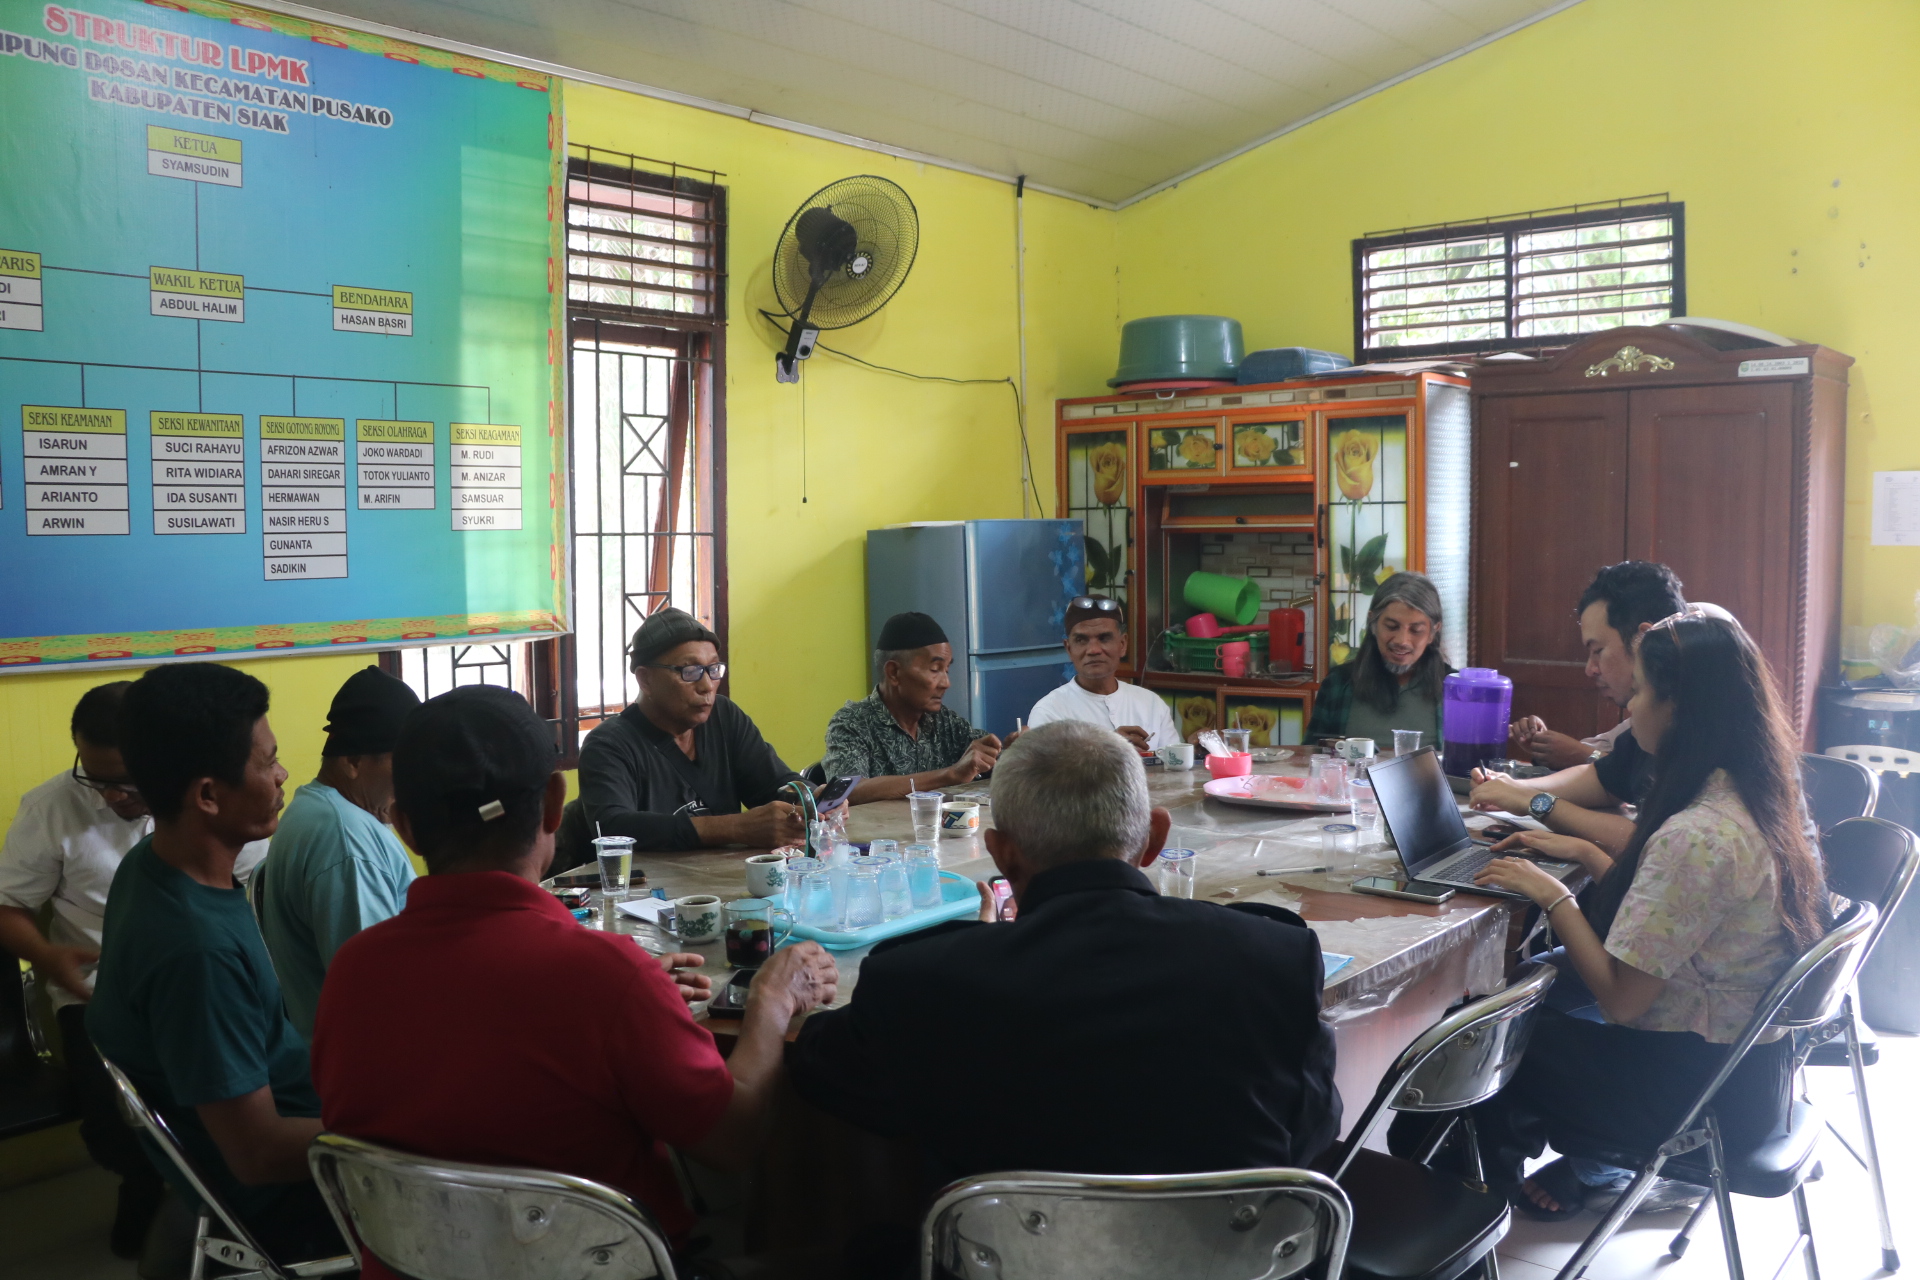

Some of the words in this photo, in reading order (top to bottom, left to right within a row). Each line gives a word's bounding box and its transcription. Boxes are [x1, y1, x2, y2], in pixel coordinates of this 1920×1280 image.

[45, 6, 222, 66] STRUKTUR
[230, 47, 308, 85] LPMK
[0, 32, 78, 67] PUNG
[84, 51, 169, 85] DOSAN
[174, 70, 307, 112] KECAMATAN
[312, 96, 392, 126] PUSAKO
[90, 79, 231, 123] KABUPATEN
[237, 107, 287, 132] SIAK
[173, 135, 218, 155] KETUA
[162, 158, 230, 179] SYAMSUDIN
[0, 256, 35, 272] ARIS
[153, 273, 195, 289] WAKIL
[199, 277, 242, 293] KETUA
[340, 291, 409, 309] BENDAHARA
[160, 298, 200, 312] ABDUL
[202, 302, 237, 315] HALIM
[341, 314, 376, 327] HASAN
[378, 317, 407, 329] BASRI
[28, 411, 58, 426] SEKSI
[60, 413, 113, 428] KEAMANAN
[158, 417, 185, 431] SEKSI
[187, 418, 240, 432] KEWANITAAN
[266, 421, 285, 434] SEKSI
[286, 423, 314, 435] GOTONG
[314, 424, 340, 436] ROYONG
[362, 425, 385, 437] SEKSI
[387, 426, 428, 439] OLAHRAGA
[456, 428, 477, 440] SEKSI
[478, 429, 520, 442] KEAGAMAAN
[39, 438, 88, 451] ISARUN
[165, 442, 193, 453] SUCI
[196, 443, 241, 455] RAHAYU
[267, 445, 306, 456] AFRIZON
[307, 446, 339, 457] AZWAR
[362, 447, 385, 458] JOKO
[386, 448, 423, 459] WARDADI
[461, 450, 471, 460] M.
[473, 450, 494, 460] RUDI
[40, 465, 87, 477] AMRAN
[89, 466, 97, 477] Y
[166, 467, 192, 478] RITA
[194, 468, 242, 479] WIDIARA
[268, 468, 301, 480] DAHARI
[303, 469, 341, 480] SIREGAR
[363, 470, 390, 481] TOTOK
[391, 471, 430, 481] YULIANTO
[461, 472, 472, 481] M.
[473, 472, 506, 482] ANIZAR
[41, 491, 98, 503] ARIANTO
[167, 492, 186, 504] IDA
[188, 492, 237, 504] SUSANTI
[269, 492, 320, 503] HERMAWAN
[363, 494, 373, 504] M.
[374, 494, 401, 504] ARIFIN
[461, 493, 504, 504] SAMSUAR
[42, 518, 85, 529] ARWIN
[167, 517, 235, 529] SUSILAWATI
[269, 516, 296, 527] NASIR
[298, 516, 322, 526] HERU
[323, 516, 329, 526] S
[462, 515, 495, 525] SYUKRI
[269, 540, 313, 550] GUNANTA
[270, 563, 307, 574] SADIKIN
